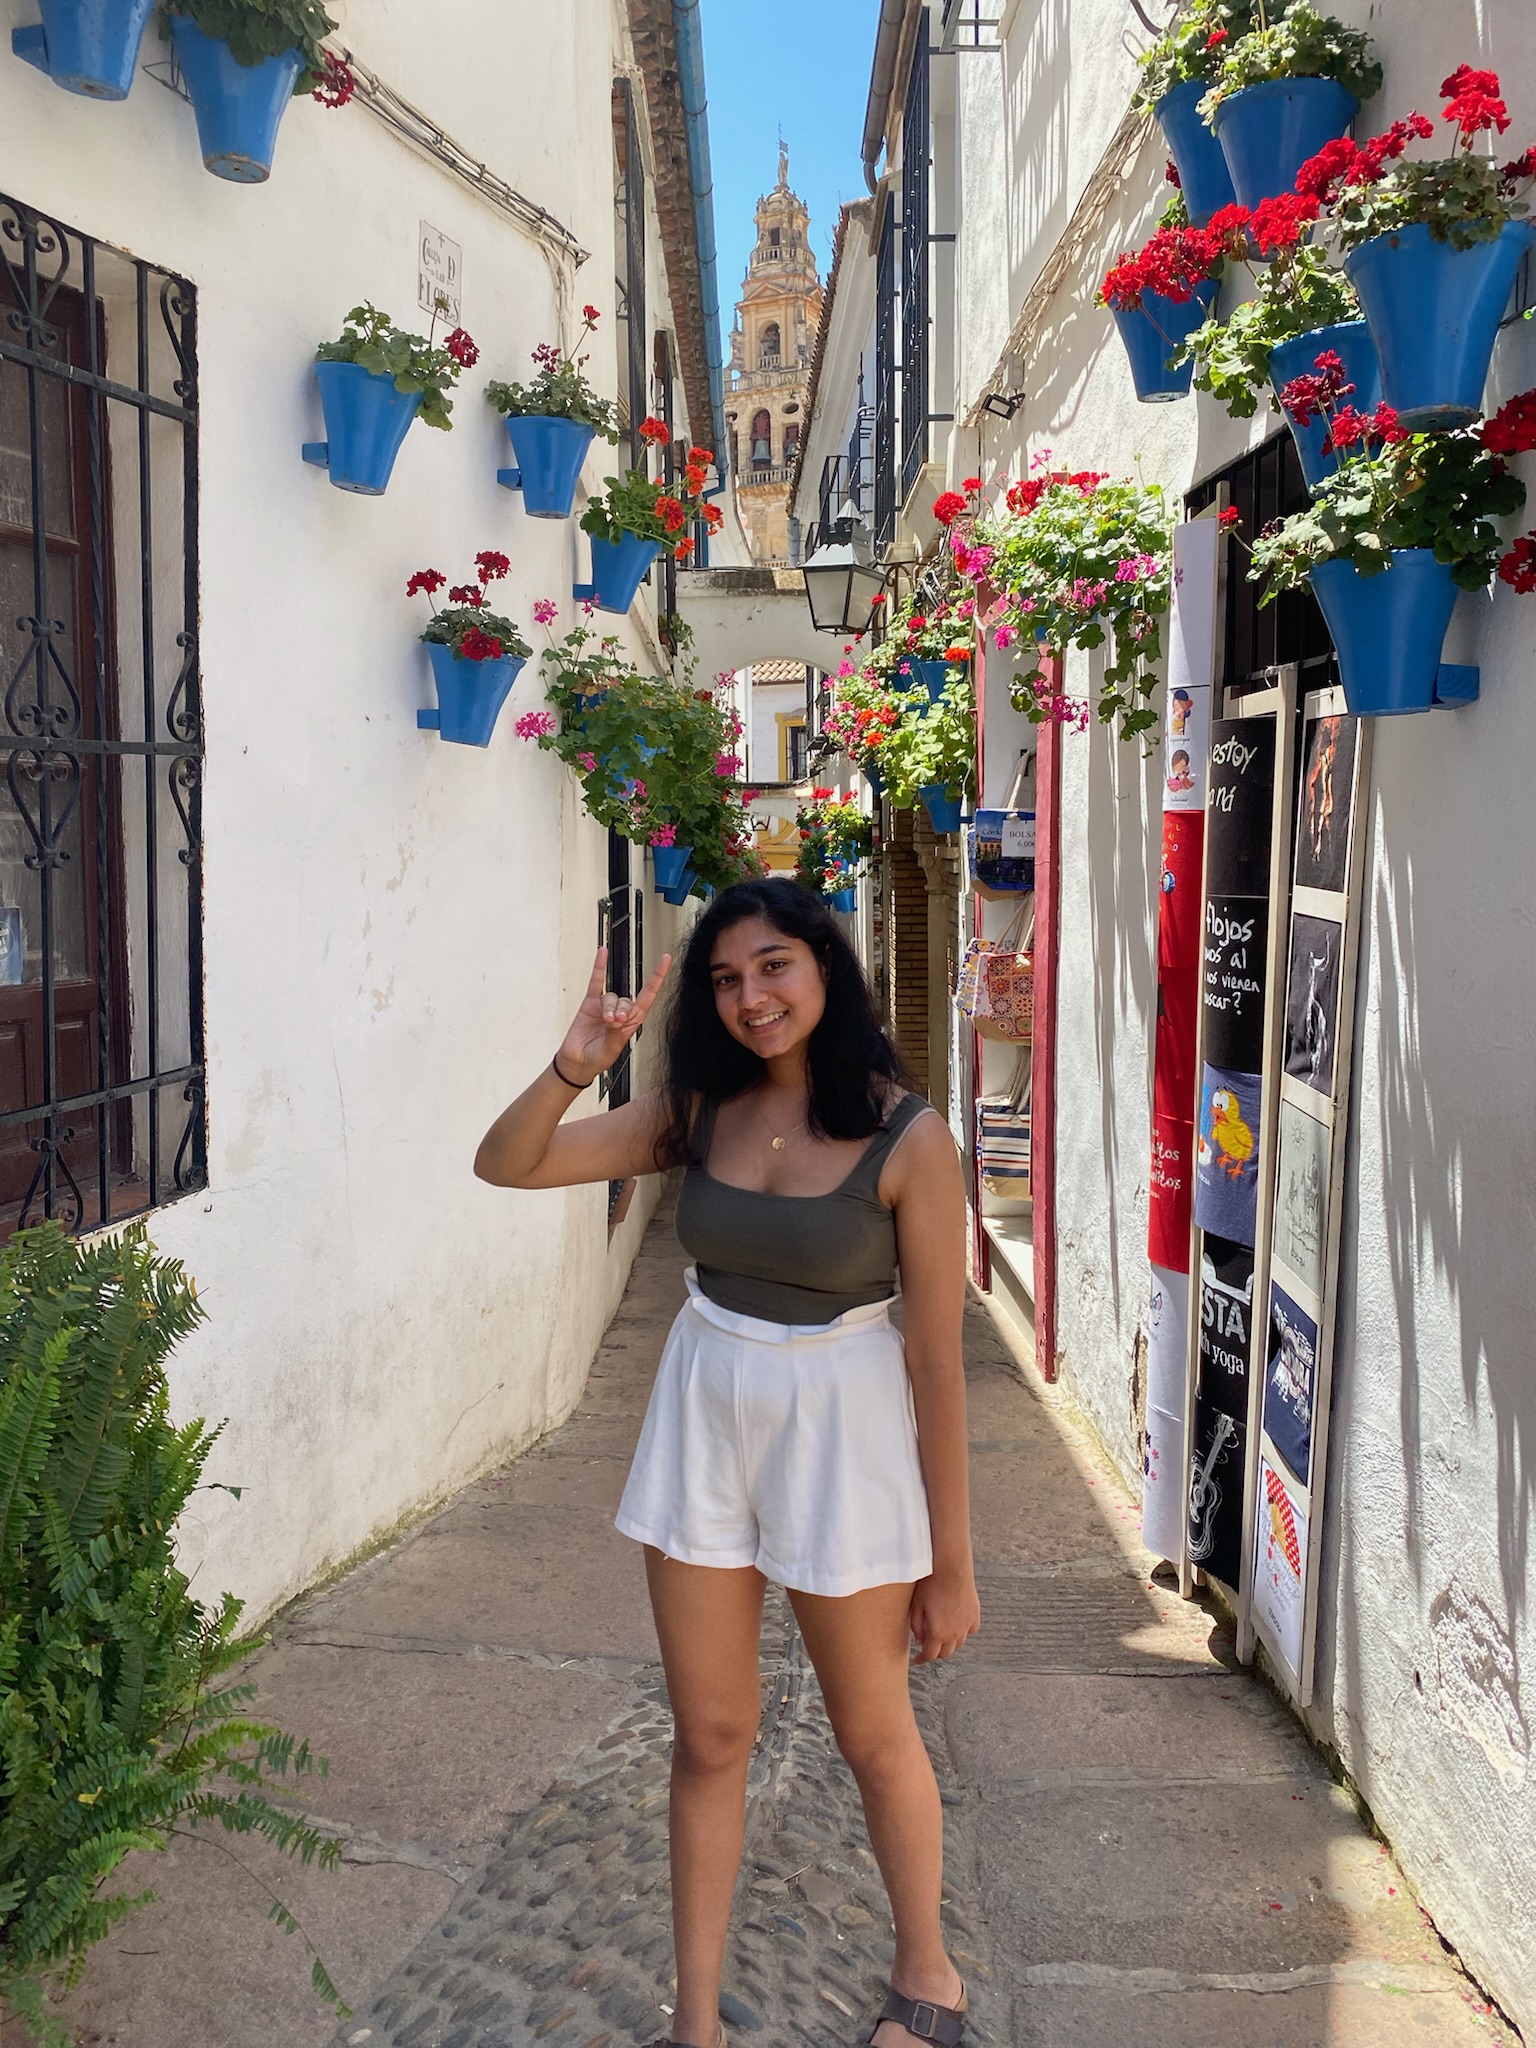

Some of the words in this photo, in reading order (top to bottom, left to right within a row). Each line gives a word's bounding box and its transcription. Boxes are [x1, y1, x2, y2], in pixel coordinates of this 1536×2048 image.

[1230, 947, 1247, 969] al
[1221, 972, 1260, 993] vienen
[1201, 1285, 1247, 1344] STA
[1212, 1344, 1245, 1375] yoga
